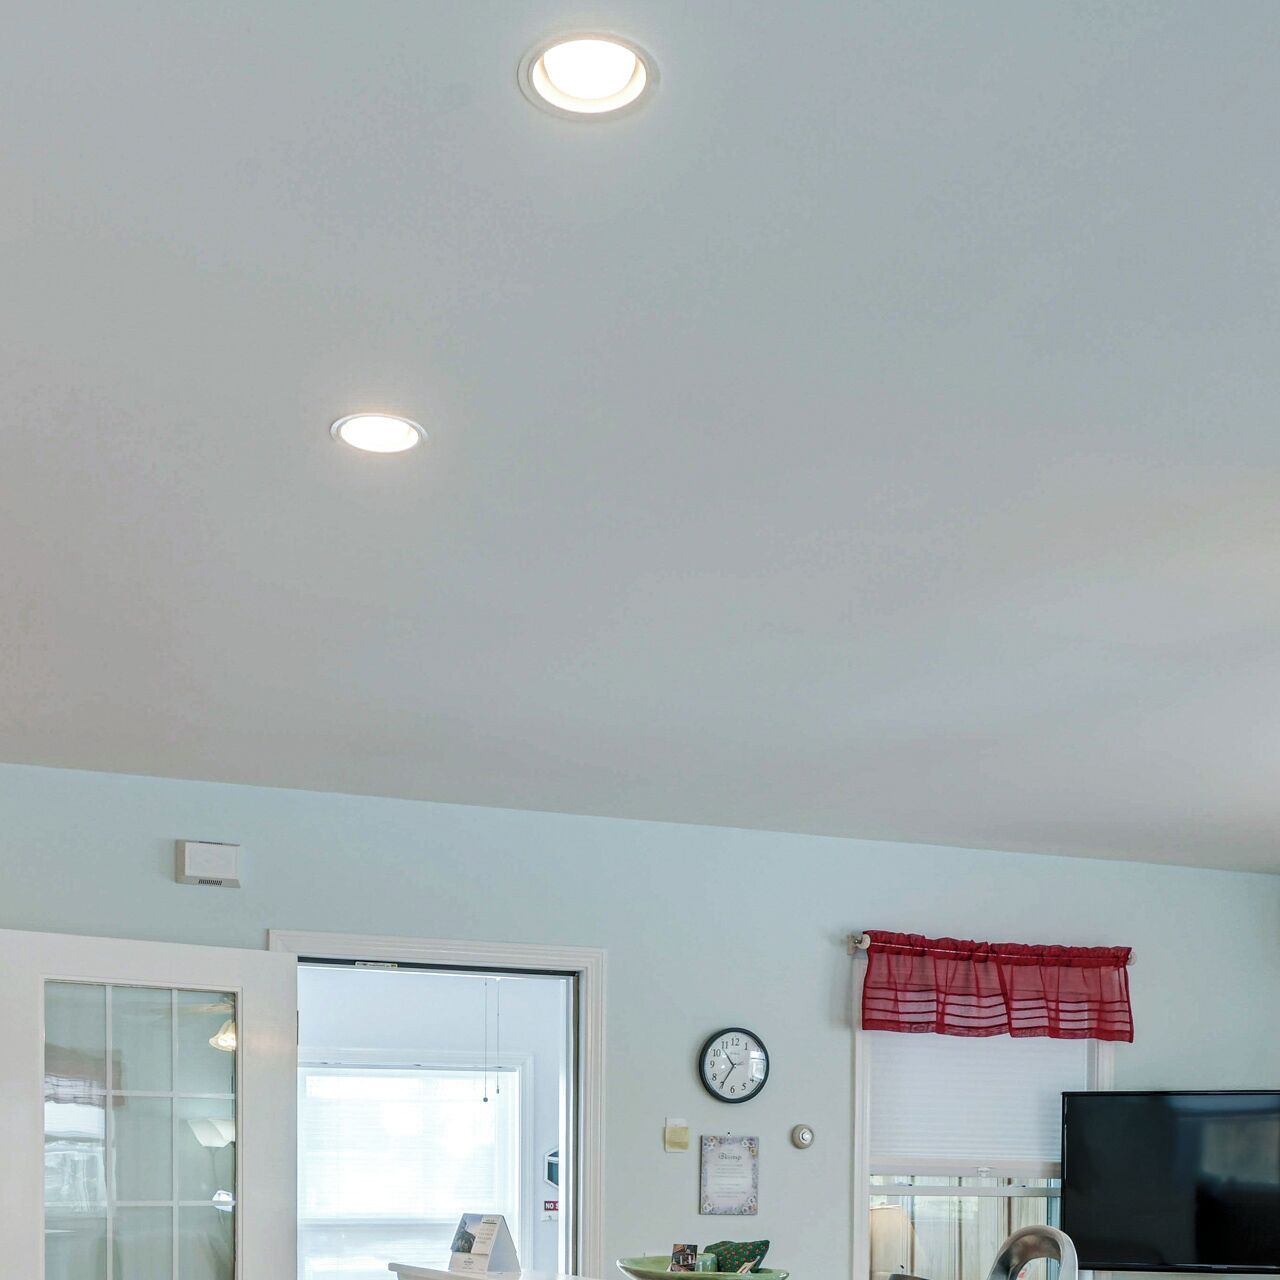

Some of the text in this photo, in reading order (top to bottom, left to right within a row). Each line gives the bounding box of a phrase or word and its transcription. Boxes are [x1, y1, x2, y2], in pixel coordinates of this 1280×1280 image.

[721, 1040, 729, 1049] 11
[730, 1037, 740, 1047] 12
[712, 1048, 721, 1057] 10
[709, 1060, 715, 1068] 9
[711, 1072, 717, 1081] 8
[730, 1085, 735, 1093] 6
[741, 1082, 747, 1091] 5
